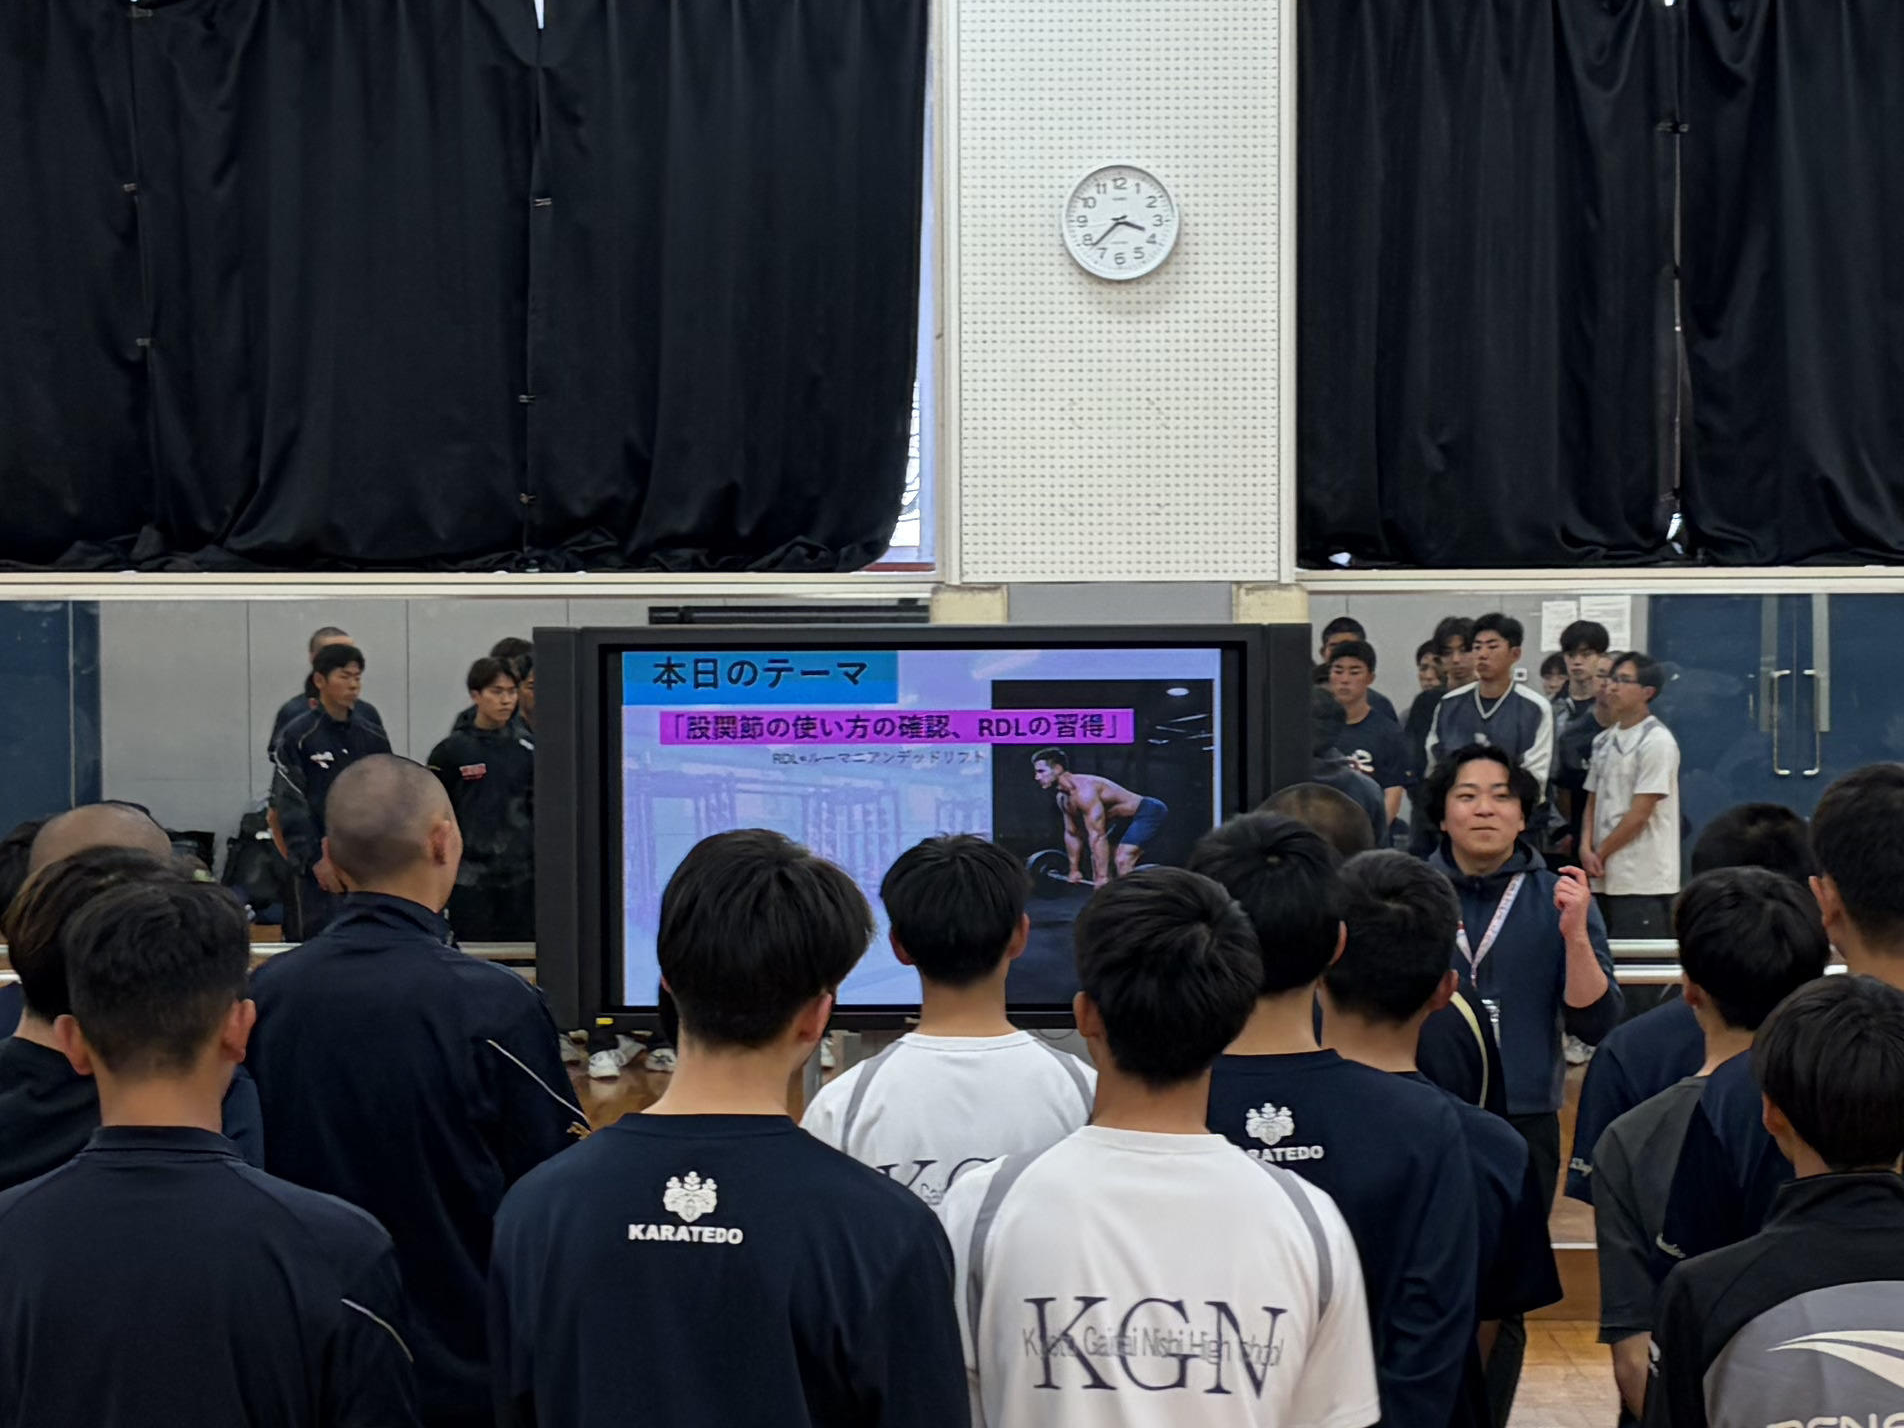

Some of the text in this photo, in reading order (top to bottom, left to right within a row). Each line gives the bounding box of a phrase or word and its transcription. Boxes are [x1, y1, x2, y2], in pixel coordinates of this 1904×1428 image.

[1096, 183, 1107, 194] 11
[1112, 177, 1127, 190] 12
[1135, 183, 1141, 194] 1
[1082, 196, 1097, 209] 10
[1145, 195, 1157, 208] 2
[1076, 215, 1088, 228] 9
[1152, 214, 1163, 227] 3
[1082, 233, 1094, 246] 8
[1145, 233, 1157, 244] 4
[1097, 247, 1108, 259] 7
[1114, 252, 1126, 265] 6
[1133, 246, 1145, 259] 5
[652, 656, 868, 691] 本日のテーマ
[628, 1224, 744, 1245] KARATEDO
[1023, 1295, 1288, 1400] KGN
